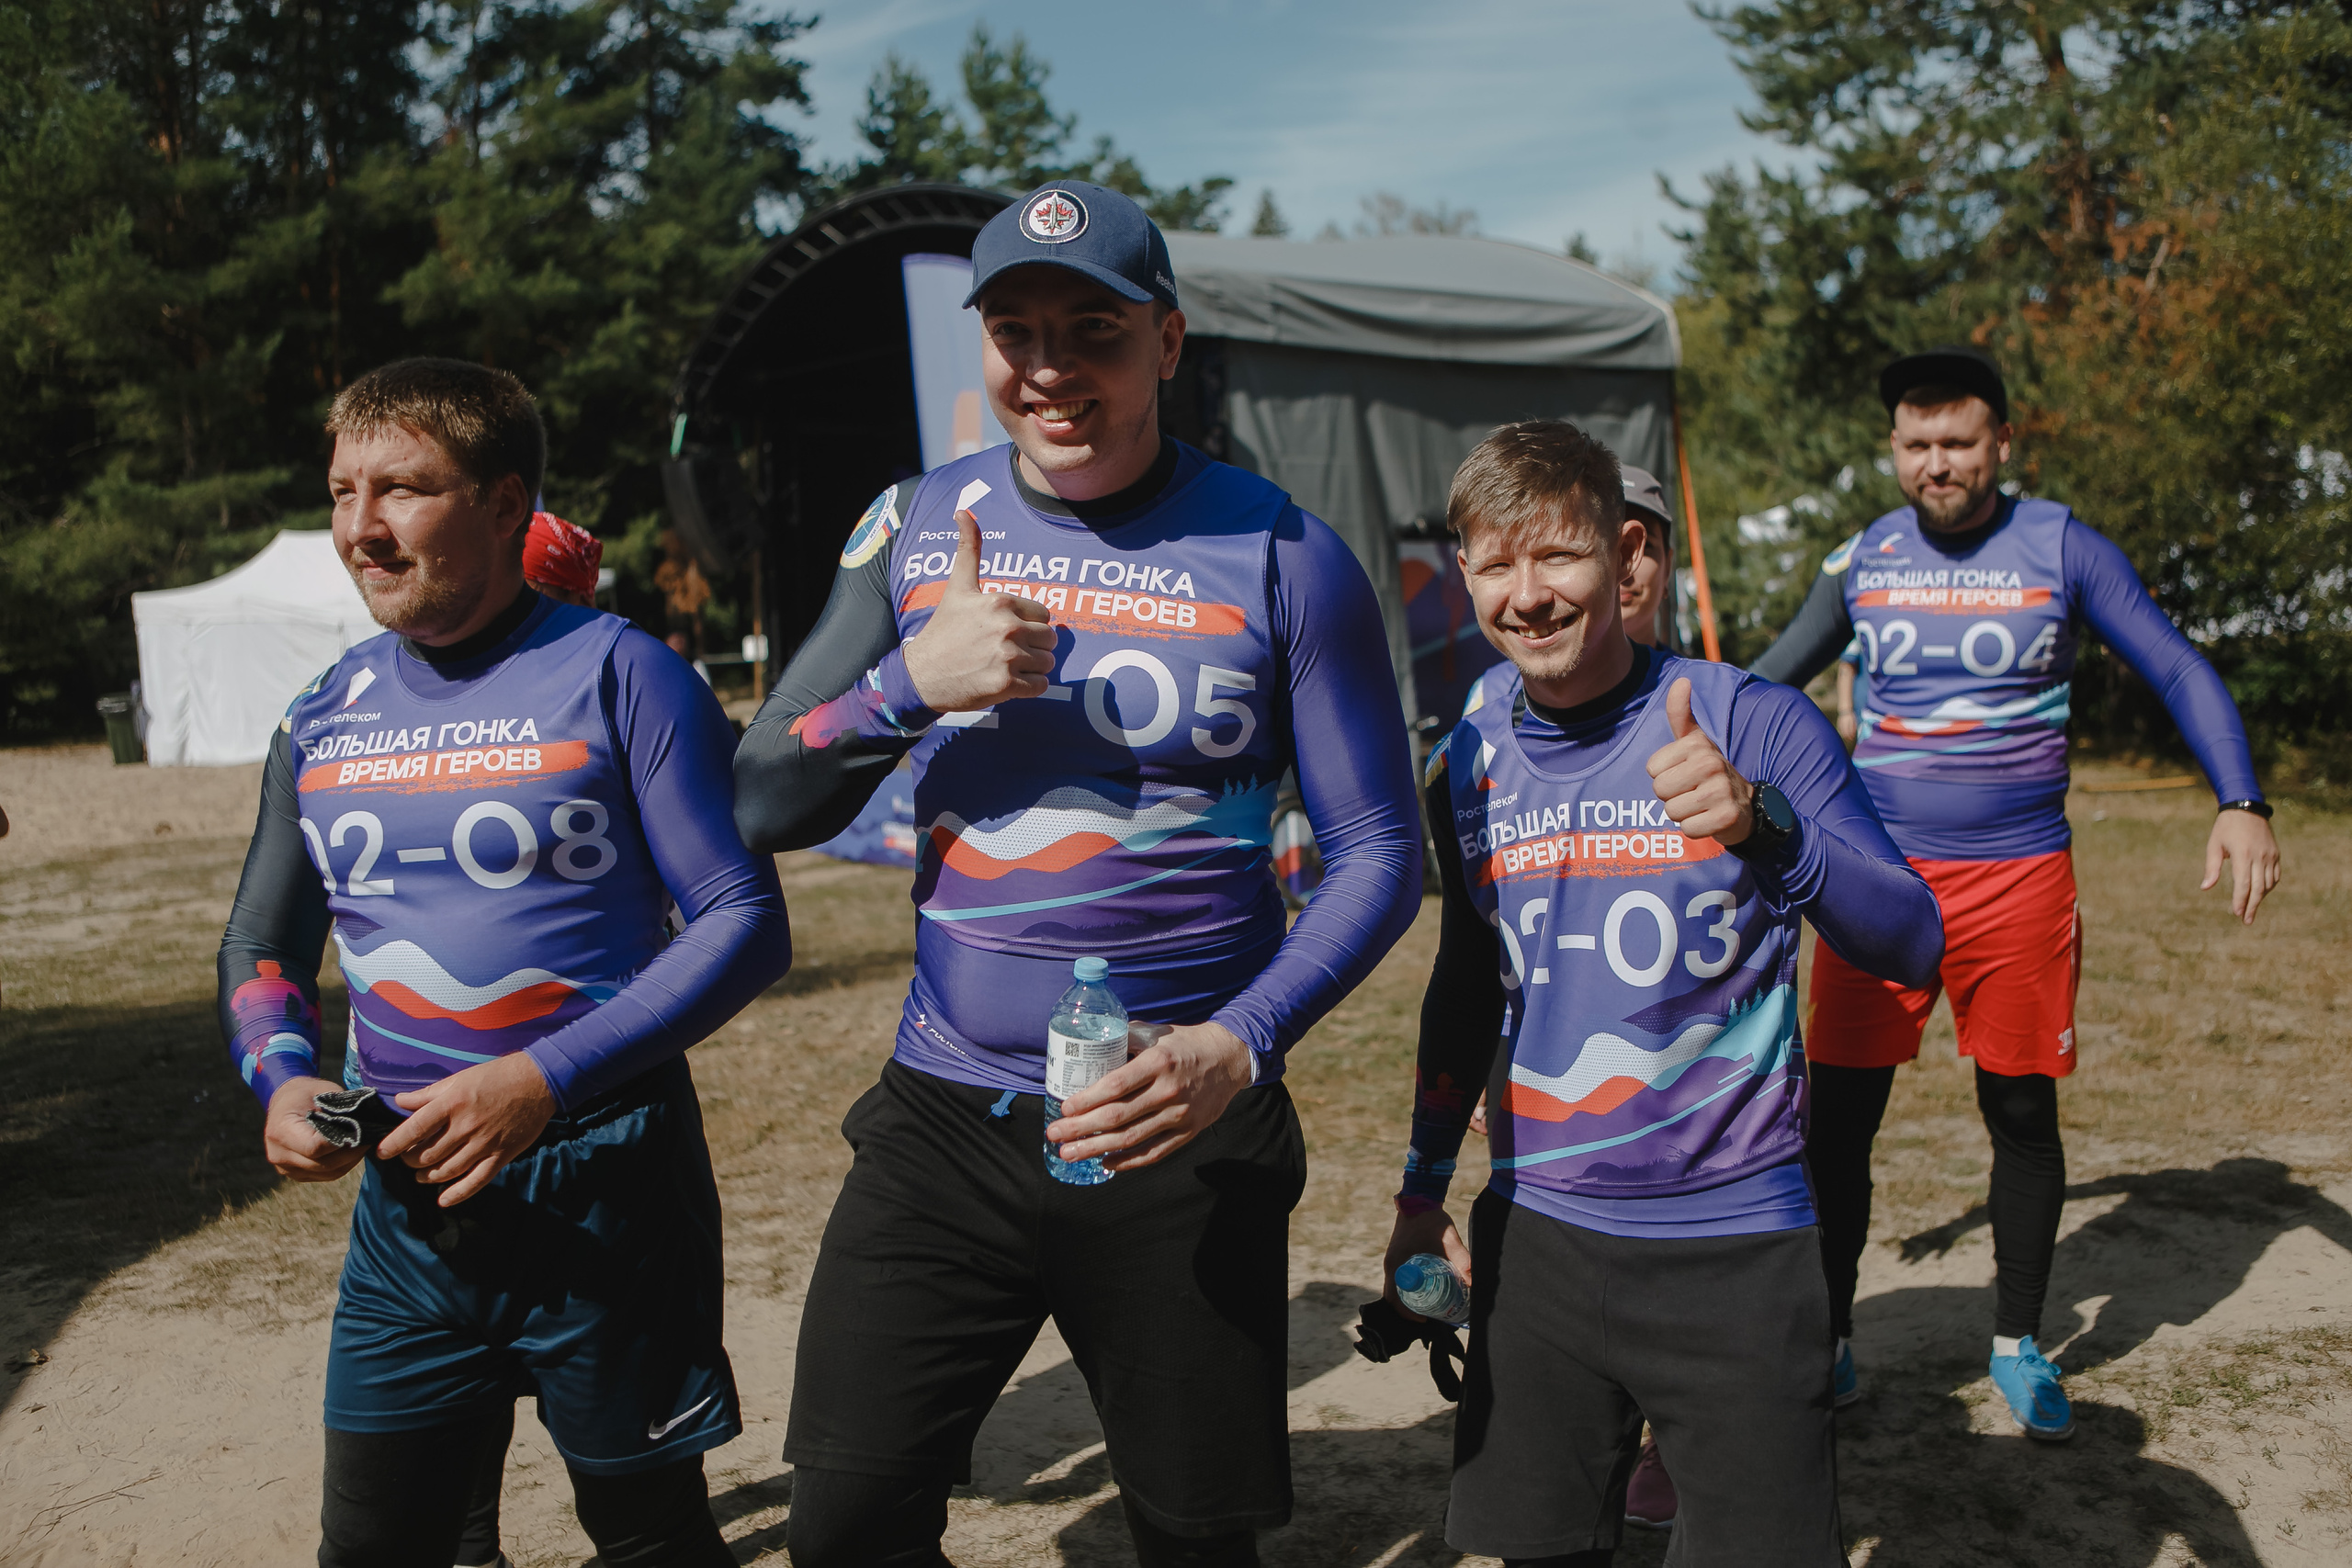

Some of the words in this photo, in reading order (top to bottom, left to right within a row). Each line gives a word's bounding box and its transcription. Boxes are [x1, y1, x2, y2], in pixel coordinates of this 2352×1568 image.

[1155, 270, 1176, 295] Reebo
[918, 530, 1006, 544] Ростеком
[1078, 558, 1196, 598] ГОНКА
[1856, 569, 1950, 591] БОЛЬШАЯ
[1951, 569, 2023, 590] ГОНКА
[978, 581, 1069, 611] РЕМЯ
[1074, 590, 1197, 628] ГЕРОЕВ
[1887, 590, 1949, 606] ВРЕМЯ
[1951, 589, 2024, 607] ГЕРОЕВ
[901, 637, 1257, 759] -05
[308, 711, 382, 730] Ртелеком
[298, 725, 433, 762] БОЛЬШАЯ
[436, 717, 540, 748] ГОНКА
[337, 755, 429, 785] ВРЕМЯ
[434, 748, 542, 776] ГЕРОЕВ
[1456, 791, 1518, 822] Ростелеком
[1459, 802, 1571, 861] БОЛЬШАЯ
[1501, 835, 1576, 874] ВРЕМЯ
[1582, 833, 1685, 860] ГЕРОЕВ
